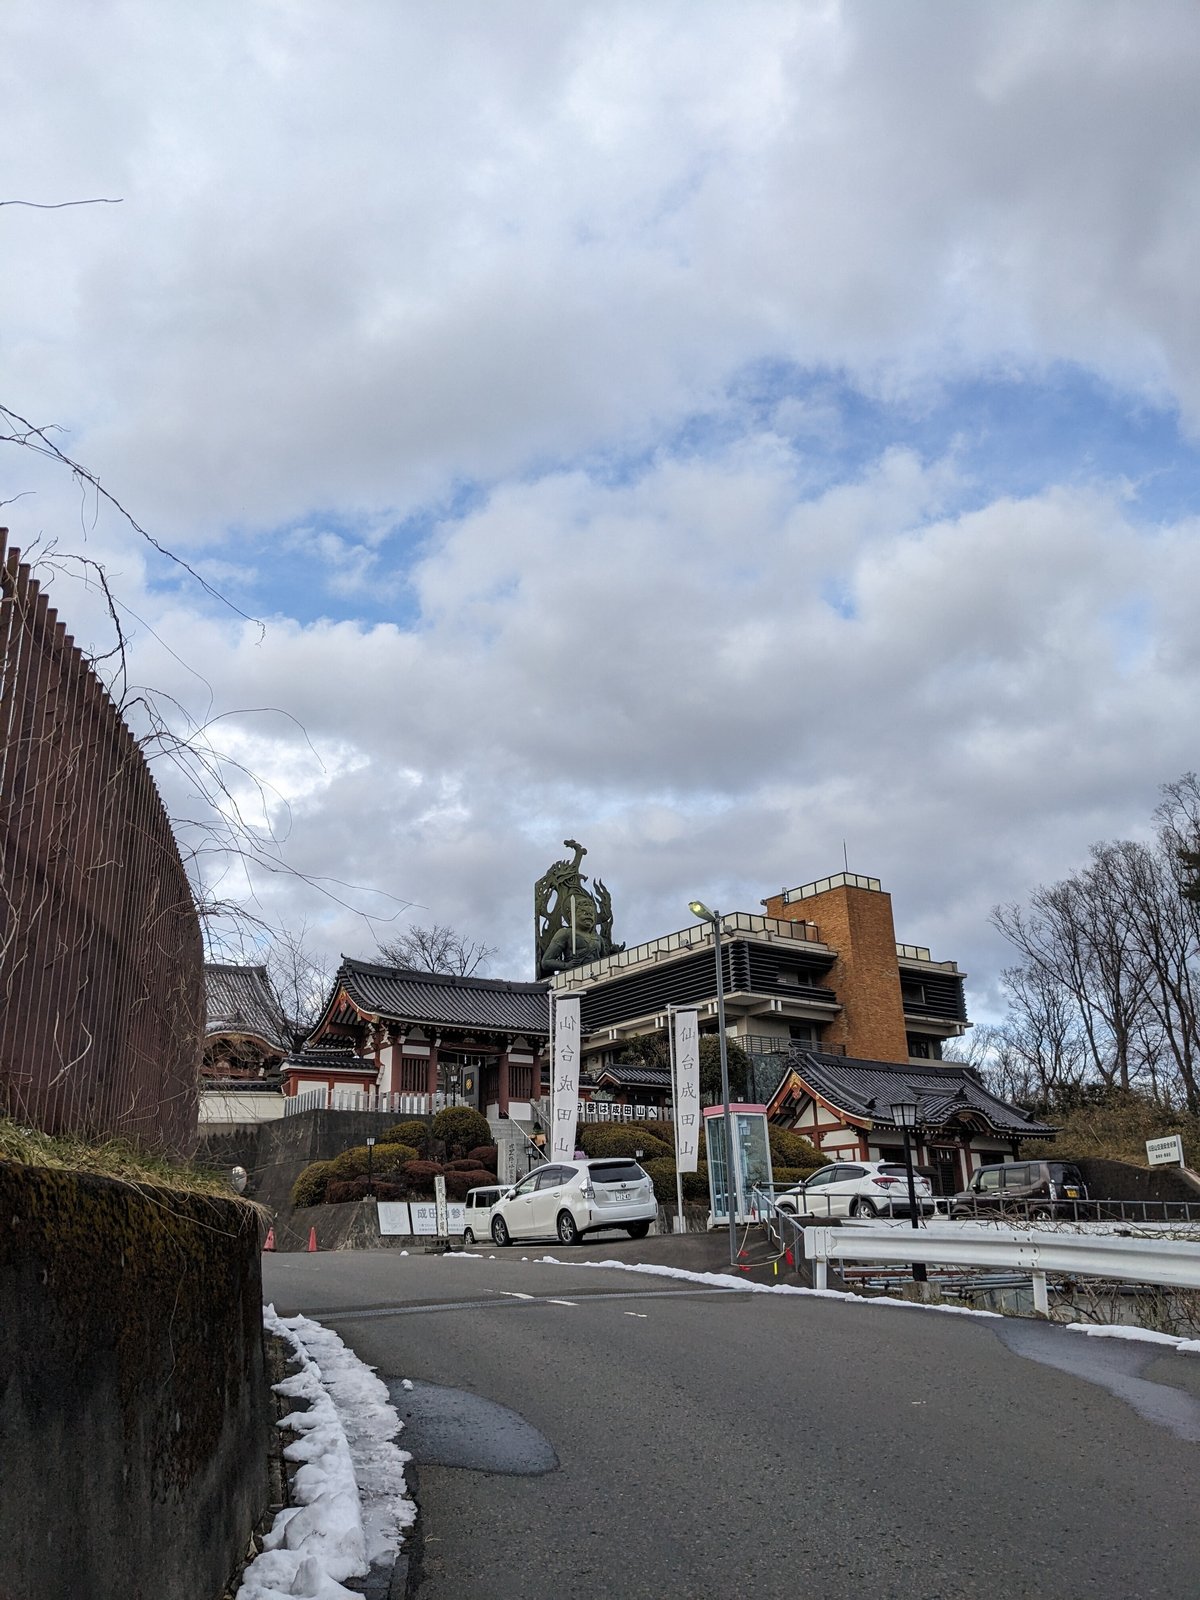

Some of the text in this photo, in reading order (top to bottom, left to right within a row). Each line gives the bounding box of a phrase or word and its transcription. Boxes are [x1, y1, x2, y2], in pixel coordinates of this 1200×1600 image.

[679, 1026, 697, 1156] 仙台成田山
[417, 1207, 465, 1219] 成田参
